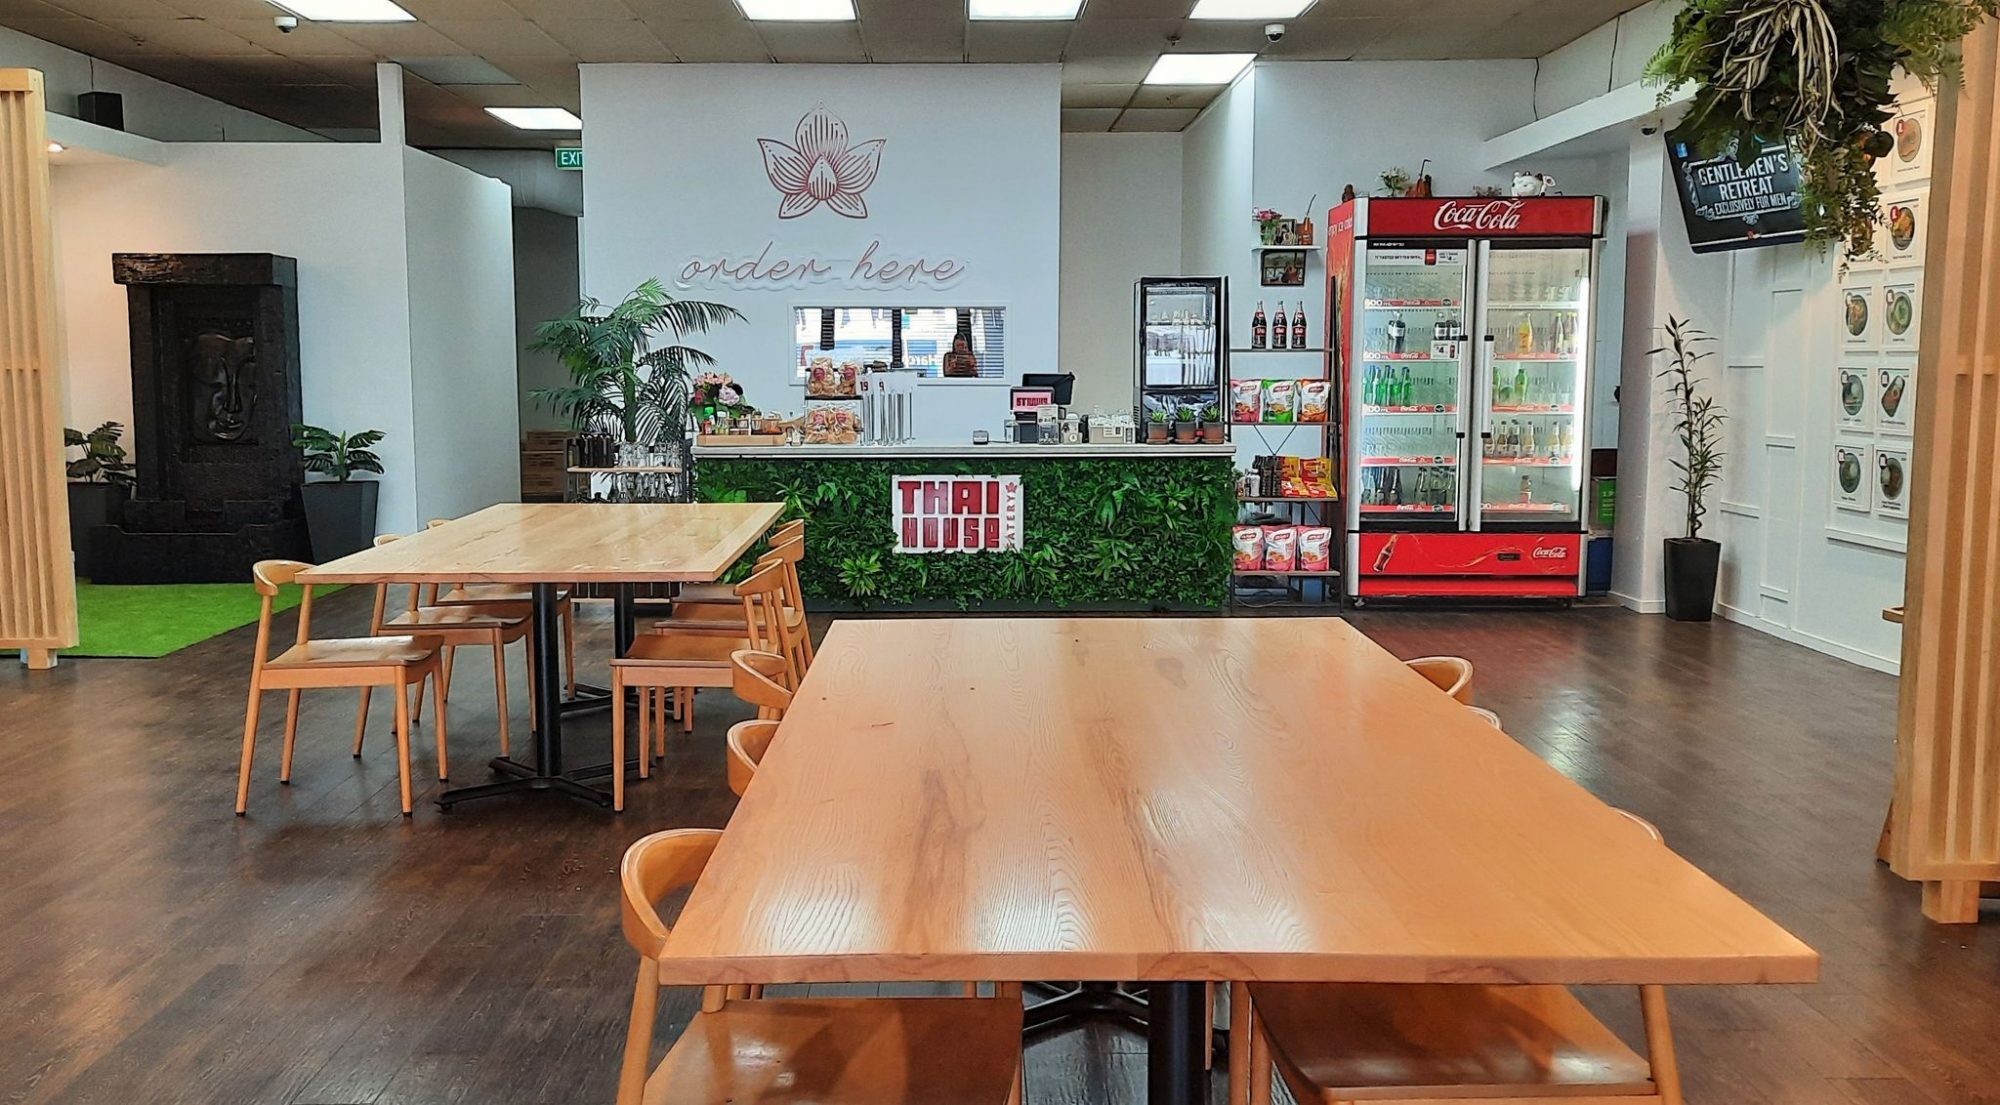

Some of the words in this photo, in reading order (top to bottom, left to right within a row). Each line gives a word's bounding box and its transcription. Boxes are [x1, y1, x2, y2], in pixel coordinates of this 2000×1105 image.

[561, 152, 582, 165] EXI
[1698, 153, 1788, 186] GENTLEMEN'S
[1718, 176, 1773, 201] RETREAT
[1433, 200, 1526, 230] Coca-Cola
[1714, 197, 1755, 215] EXCLUSIVELY
[1755, 195, 1770, 209] FOR
[1770, 192, 1787, 207] MEN
[681, 241, 831, 281] order
[850, 240, 965, 282] here
[860, 381, 869, 391] 19
[879, 381, 885, 391] 9
[898, 481, 999, 514] THAI
[1533, 547, 1568, 559] Coca-Cola
